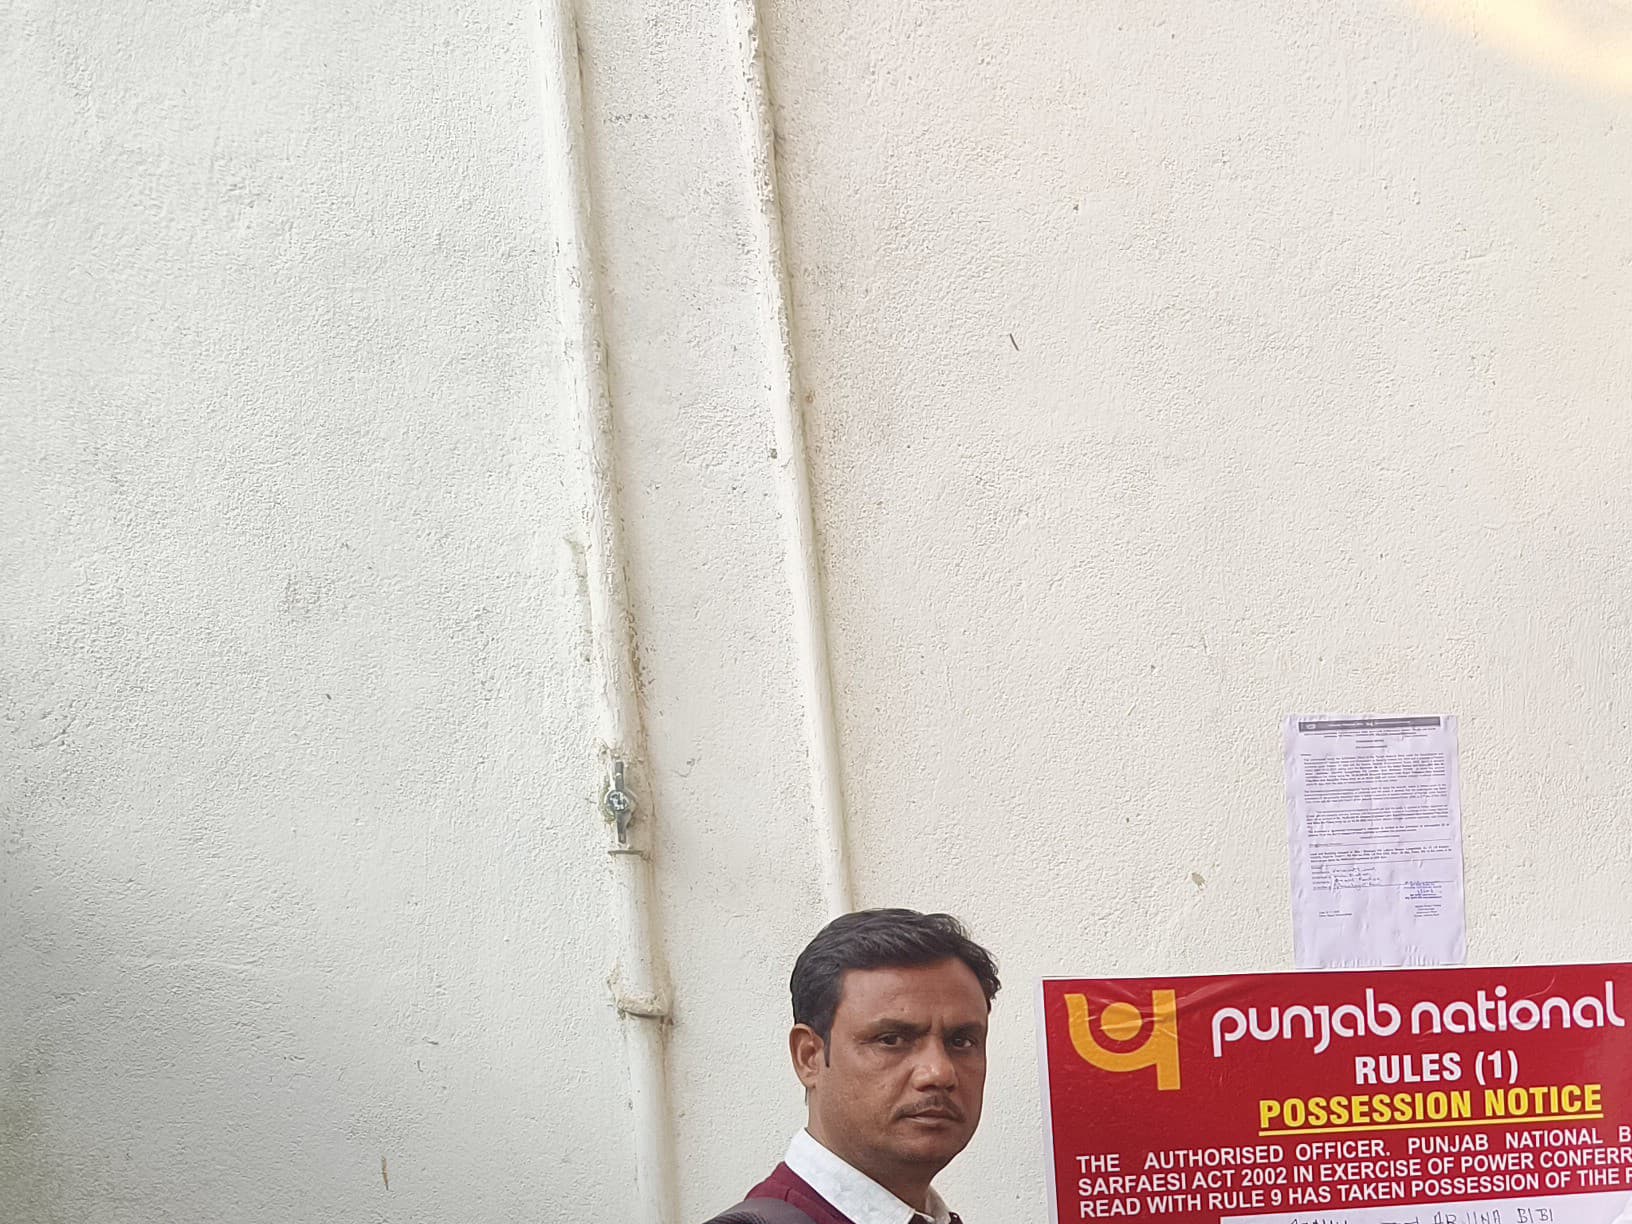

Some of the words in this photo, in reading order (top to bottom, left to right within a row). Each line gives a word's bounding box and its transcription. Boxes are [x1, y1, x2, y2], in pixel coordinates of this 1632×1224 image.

[1211, 987, 1401, 1057] punjab
[1411, 980, 1626, 1035] national
[1355, 1052, 1462, 1085] RULES
[1474, 1050, 1519, 1086] (1)
[1259, 1090, 1472, 1130] POSSESSION
[1485, 1083, 1603, 1118] NOTICE
[1076, 1154, 1121, 1174] THE
[1143, 1145, 1284, 1171] AUTHORISED
[1295, 1139, 1391, 1162] OFFICER.
[1407, 1134, 1489, 1155] PUNJAB
[1505, 1128, 1603, 1150] NATIONAL
[1078, 1172, 1187, 1197] SARFAESI
[1191, 1170, 1236, 1190] ACT
[1241, 1166, 1288, 1187] 2002
[1293, 1165, 1313, 1184] IN
[1319, 1159, 1422, 1182] EXERCISE
[1427, 1156, 1455, 1176] OF
[1460, 1152, 1535, 1174] POWER
[1080, 1197, 1142, 1219] READ
[1147, 1194, 1202, 1214] WITH
[1208, 1190, 1265, 1211] RULE
[1270, 1189, 1283, 1207] 9
[1288, 1185, 1332, 1206] HAS
[1337, 1180, 1405, 1202] TAKEN
[1411, 1173, 1540, 1198] POSSESSION
[1545, 1171, 1572, 1190] OF
[1576, 1168, 1620, 1187] TIHE
